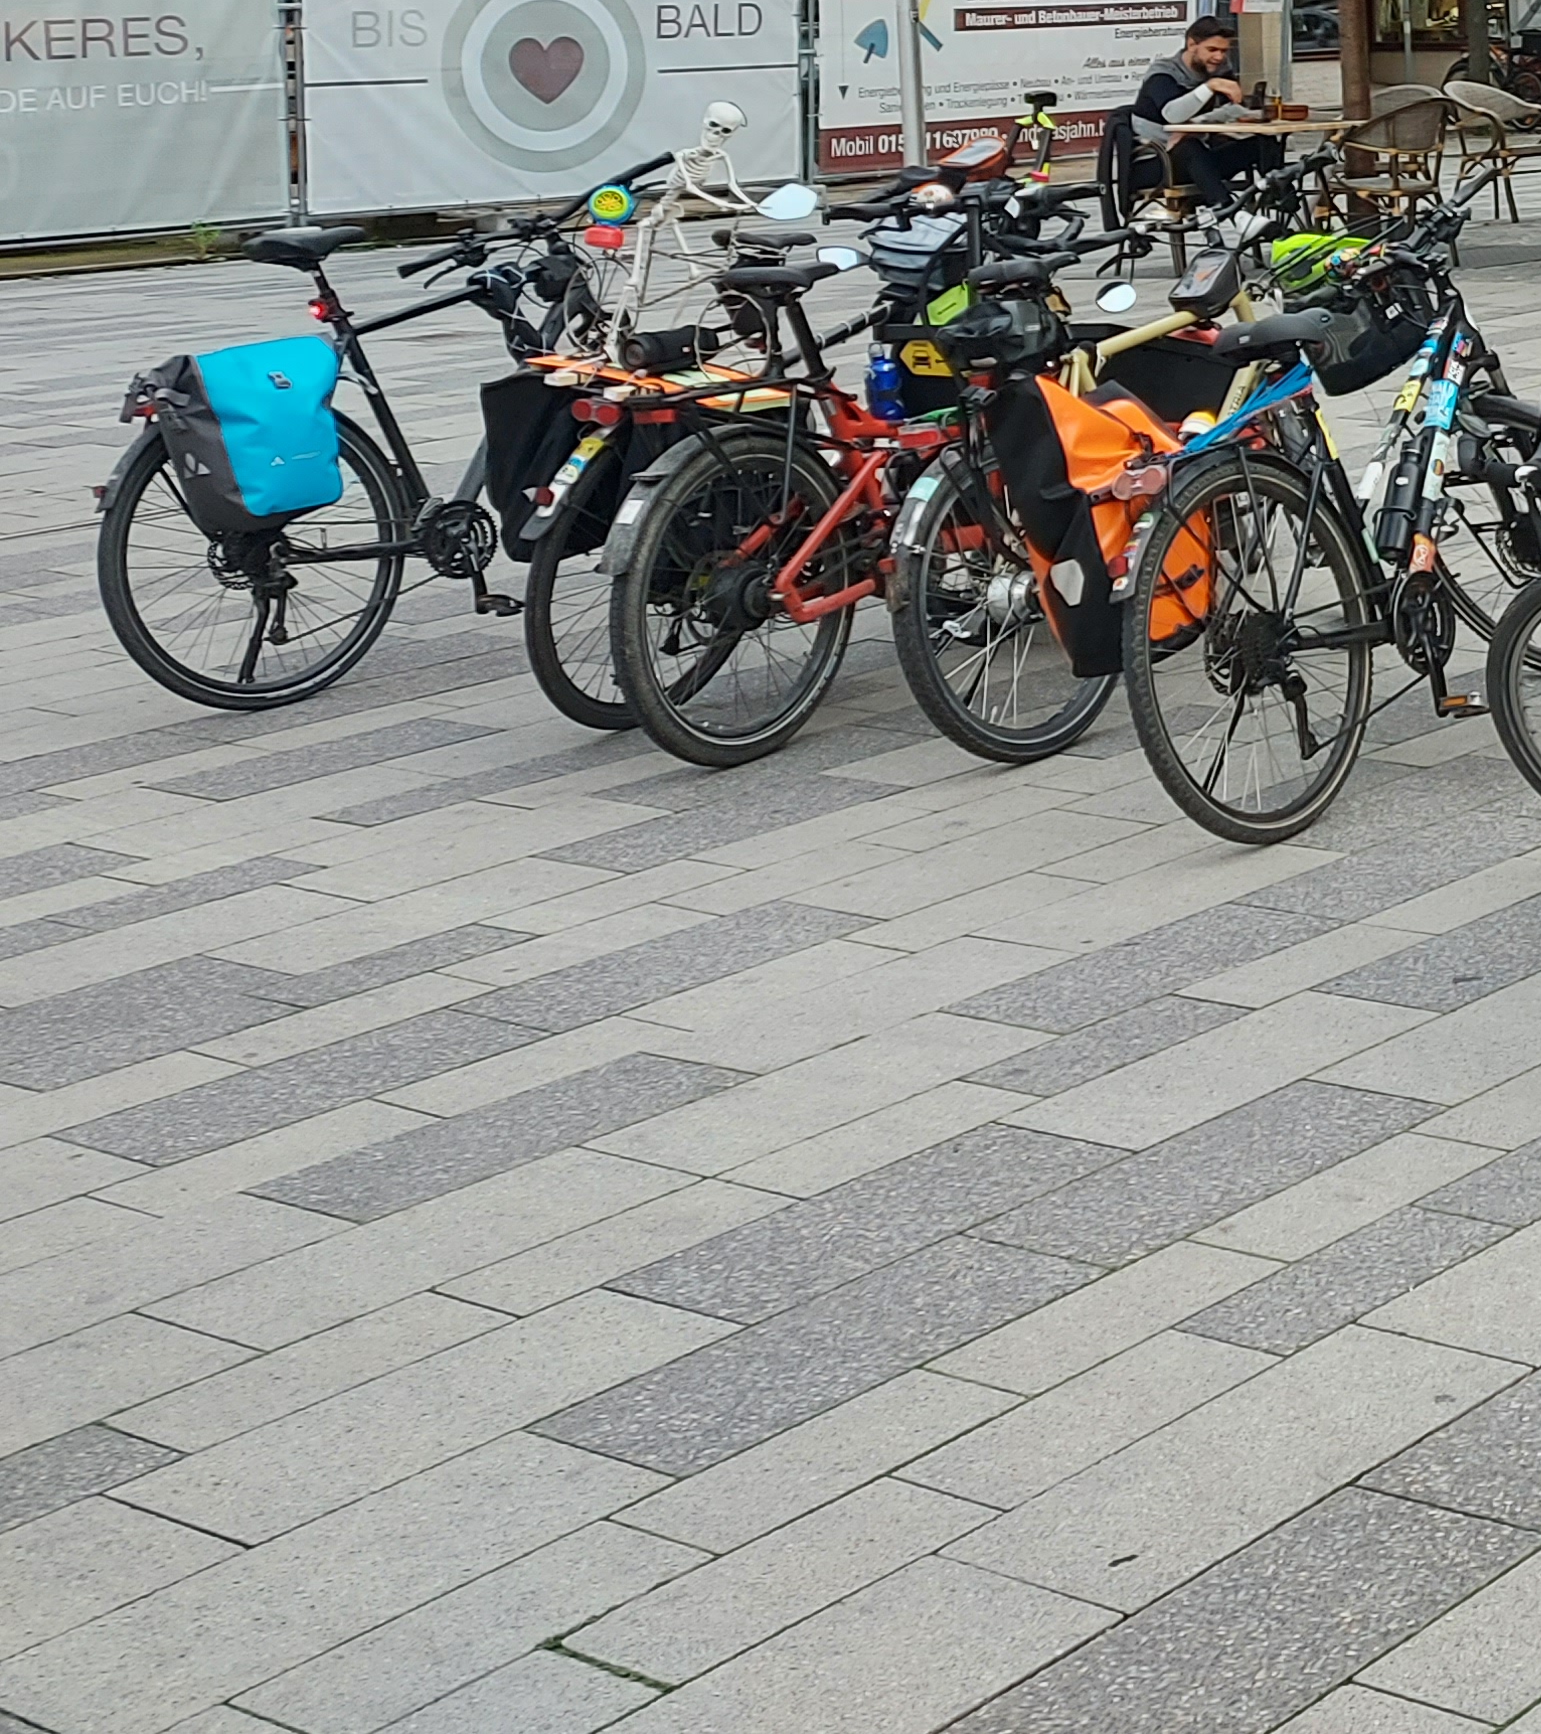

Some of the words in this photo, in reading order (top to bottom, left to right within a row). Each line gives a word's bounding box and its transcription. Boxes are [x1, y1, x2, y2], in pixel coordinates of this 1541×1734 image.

[351, 9, 429, 49] BIS
[656, 2, 763, 40] BALD
[965, 12, 1012, 27] Maurer-
[1014, 11, 1036, 25] und
[46, 84, 107, 111] AUF
[116, 79, 208, 108] EUCH!
[830, 134, 874, 158] Mobil
